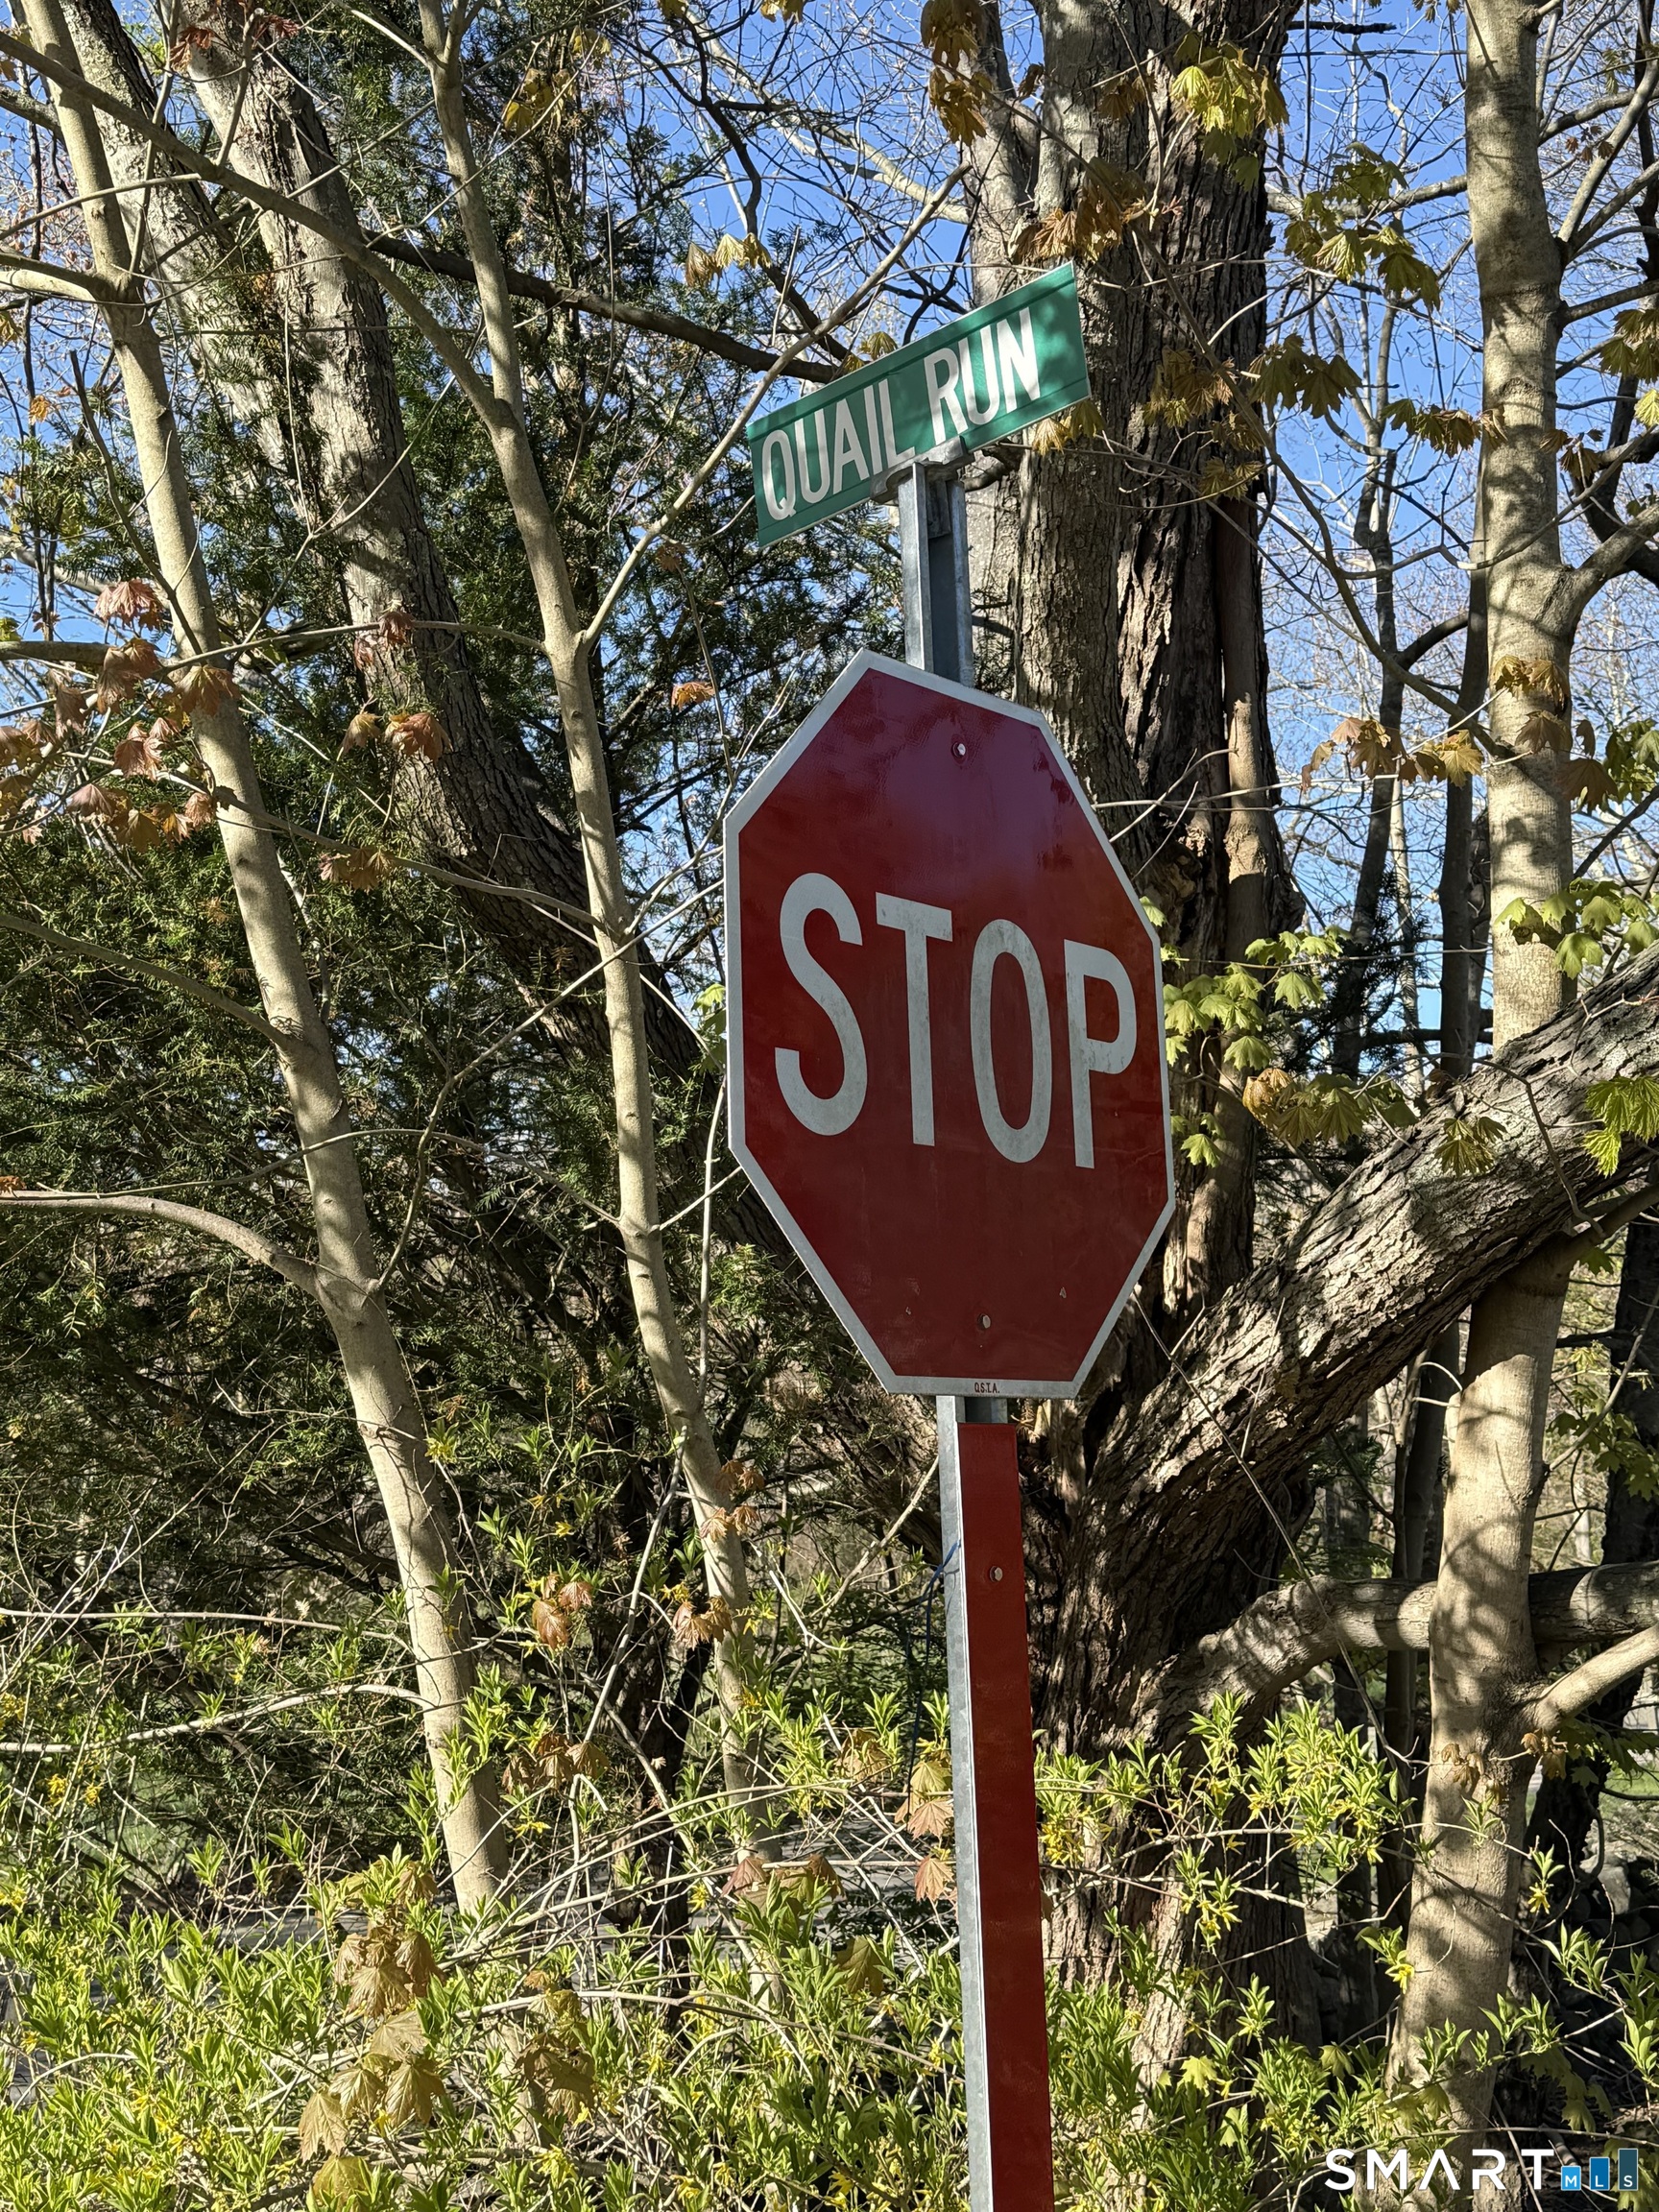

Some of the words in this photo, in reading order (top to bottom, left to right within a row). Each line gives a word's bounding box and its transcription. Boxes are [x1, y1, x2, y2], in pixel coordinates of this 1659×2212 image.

[762, 378, 916, 520] QUAIL
[924, 306, 1041, 446] RUN
[775, 872, 1138, 1169] STOP
